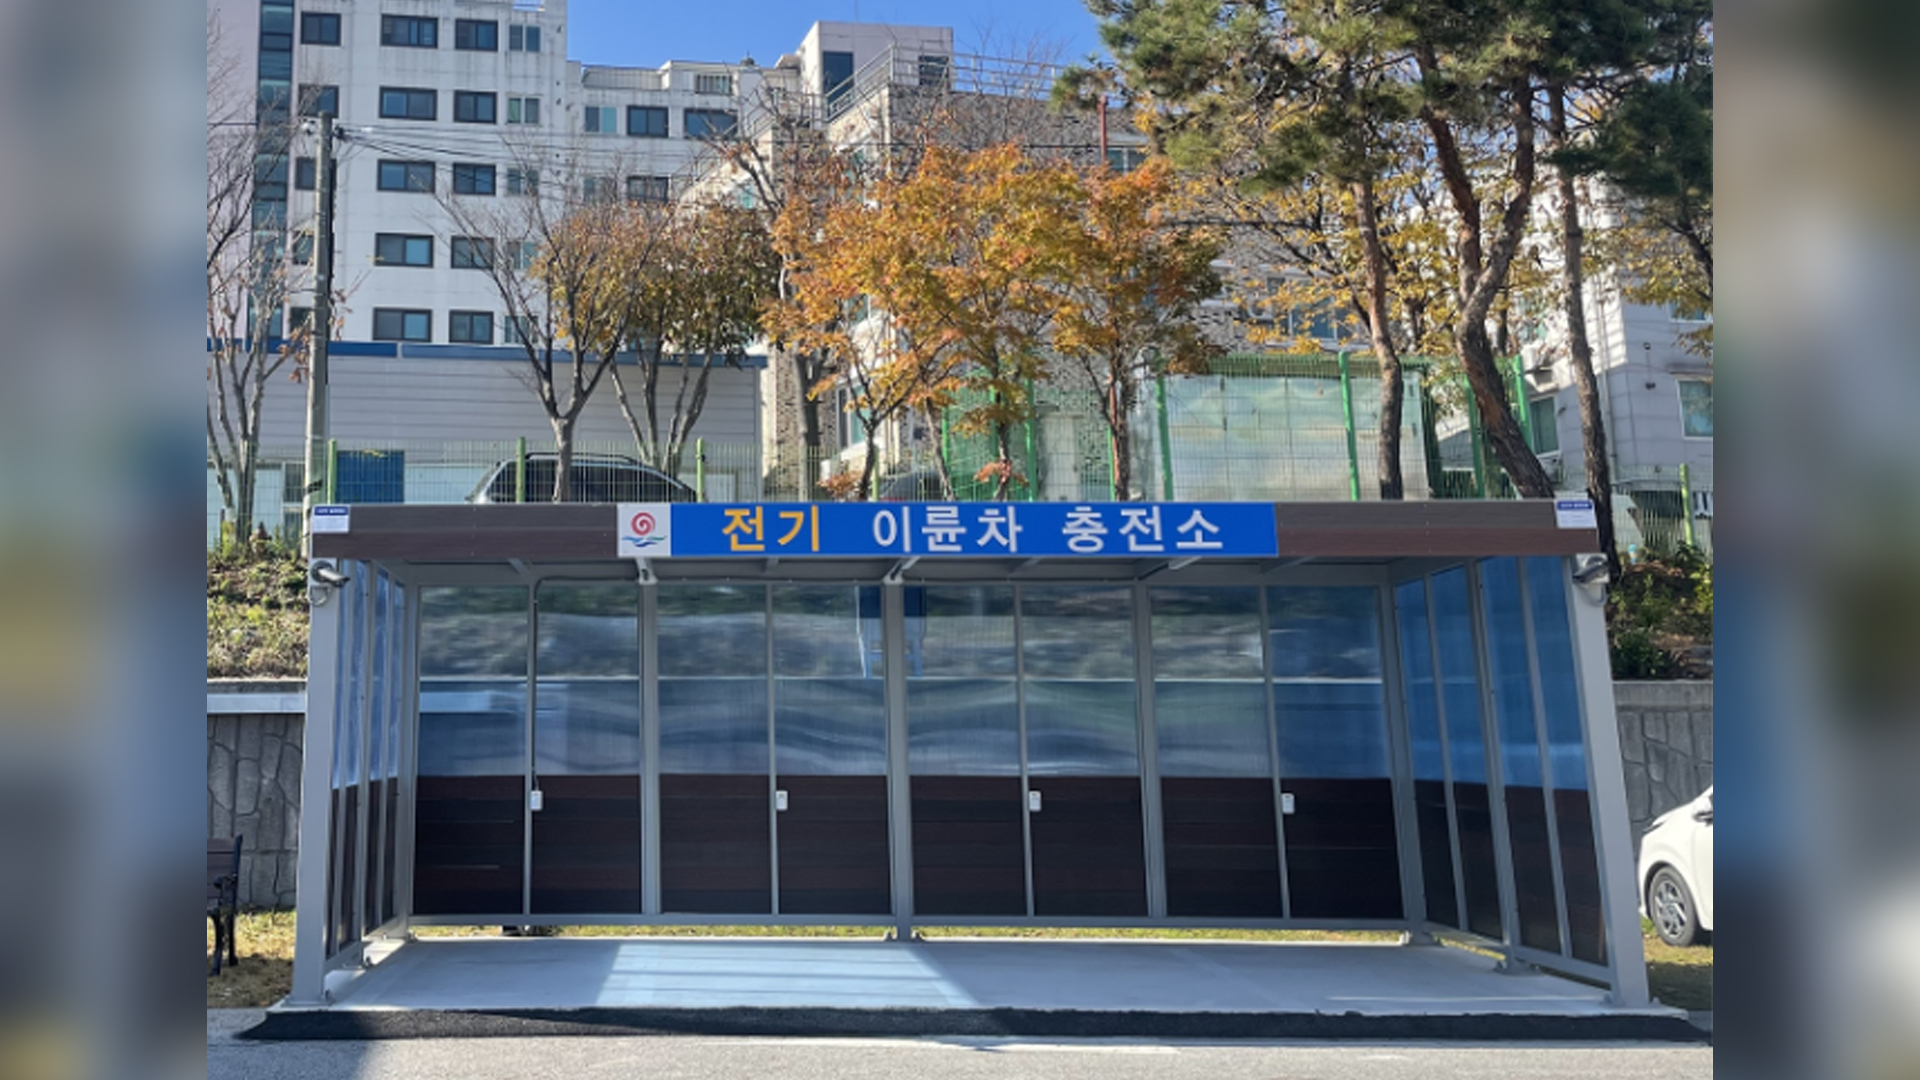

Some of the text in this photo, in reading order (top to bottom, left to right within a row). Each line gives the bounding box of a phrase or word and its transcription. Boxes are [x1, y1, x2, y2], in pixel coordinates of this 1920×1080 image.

[722, 505, 1223, 553] 전기 이륜차 충전소
